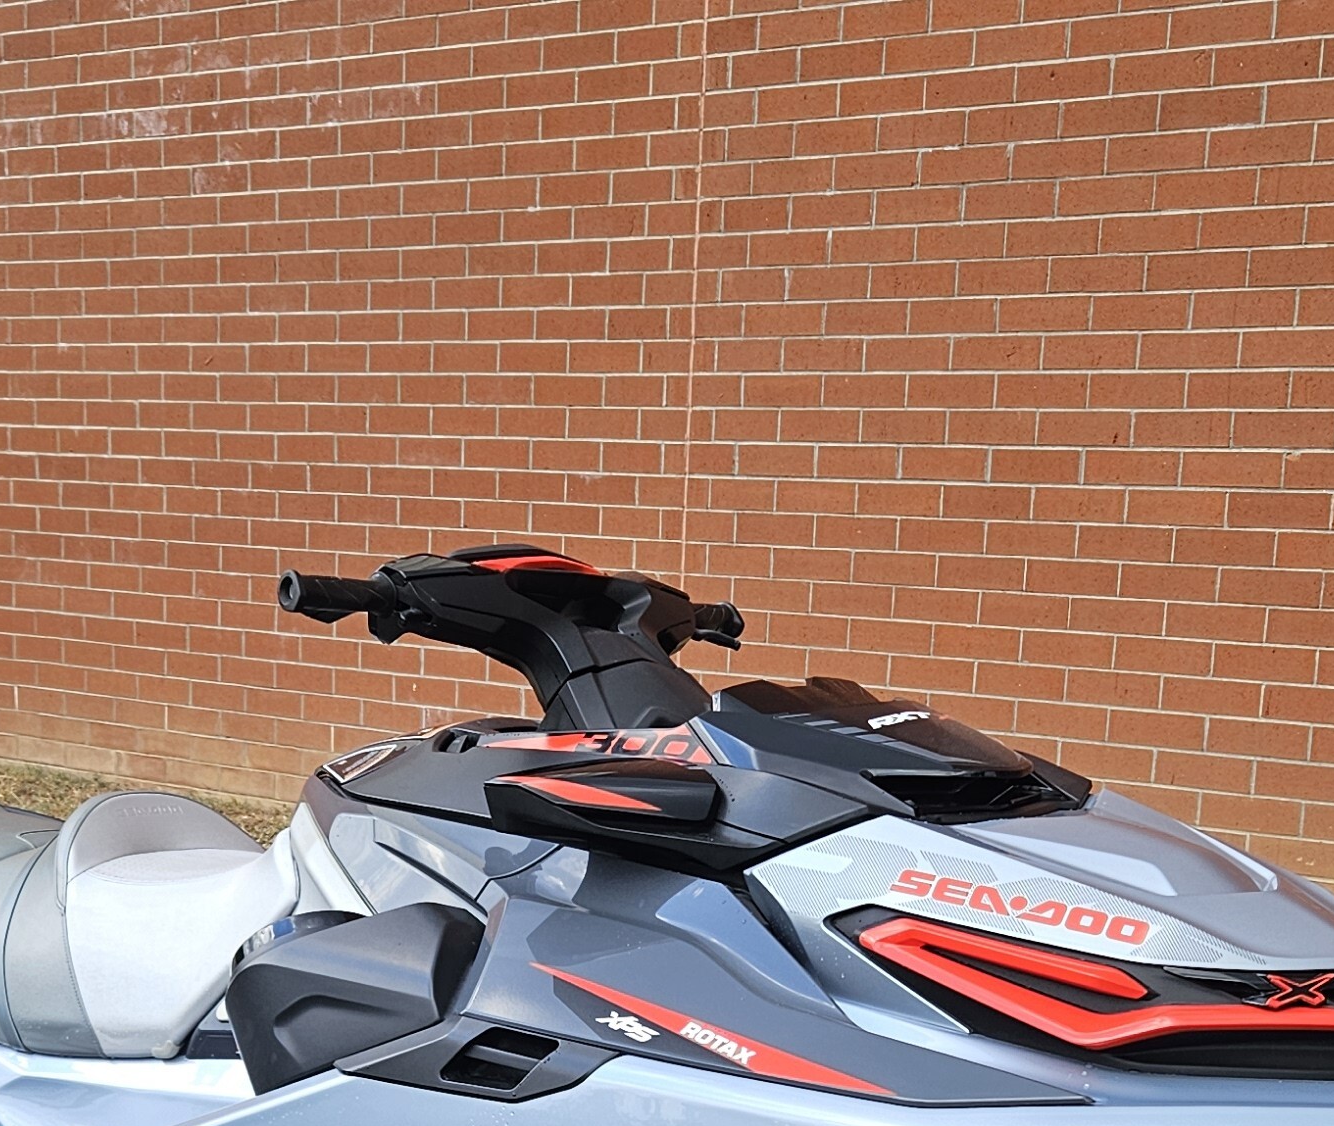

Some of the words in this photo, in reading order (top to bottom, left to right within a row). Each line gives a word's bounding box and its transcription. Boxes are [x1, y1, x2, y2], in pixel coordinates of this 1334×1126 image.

[575, 730, 700, 760] 300
[595, 1010, 661, 1043] XPS
[679, 1021, 757, 1065] ROTAX
